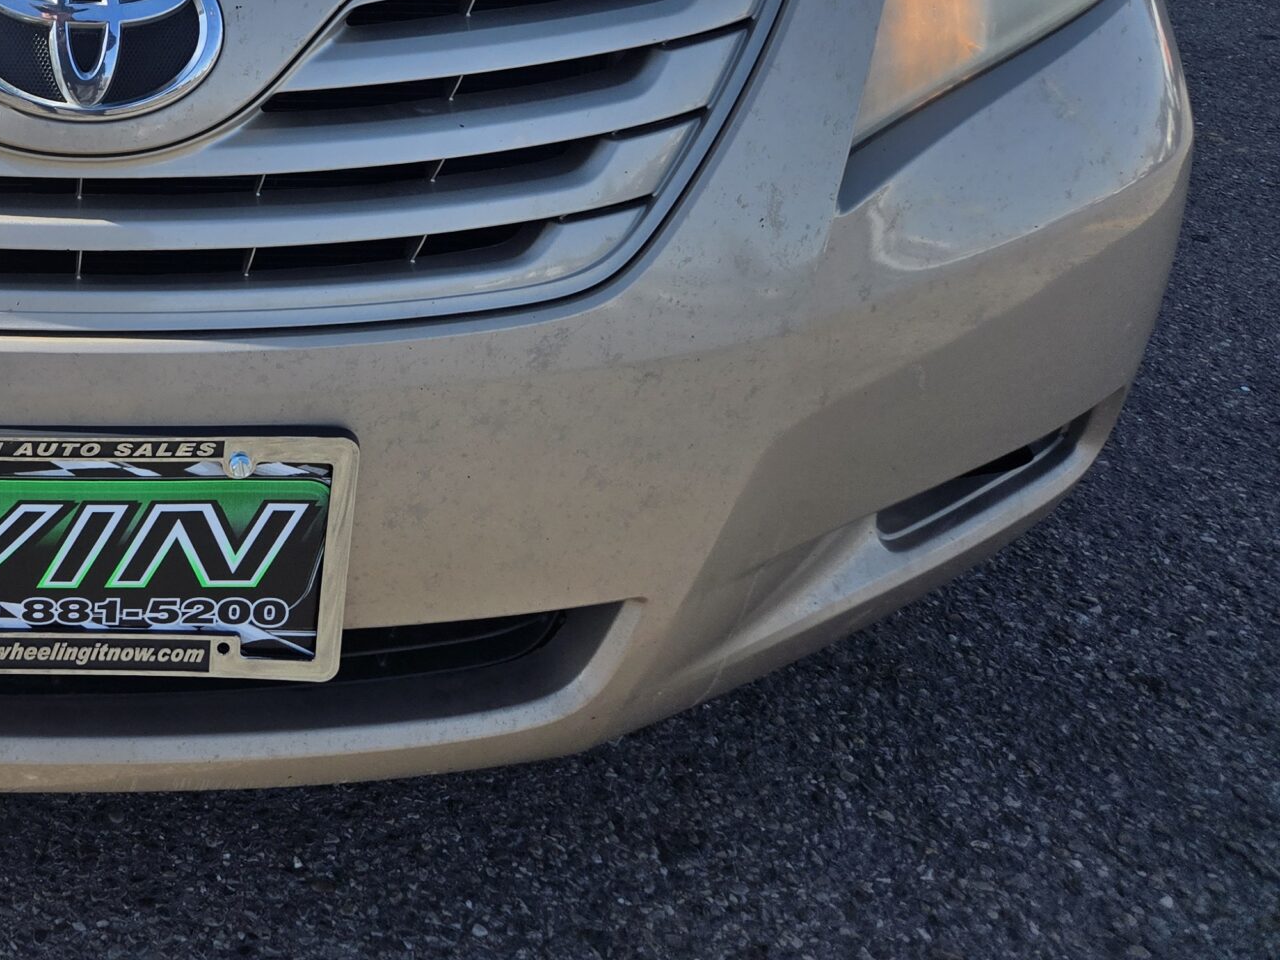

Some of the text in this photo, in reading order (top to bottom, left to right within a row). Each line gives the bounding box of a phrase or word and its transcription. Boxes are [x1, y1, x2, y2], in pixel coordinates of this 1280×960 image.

[12, 441, 102, 456] AUTO
[113, 442, 217, 457] SALES
[19, 596, 290, 628] 881-5200
